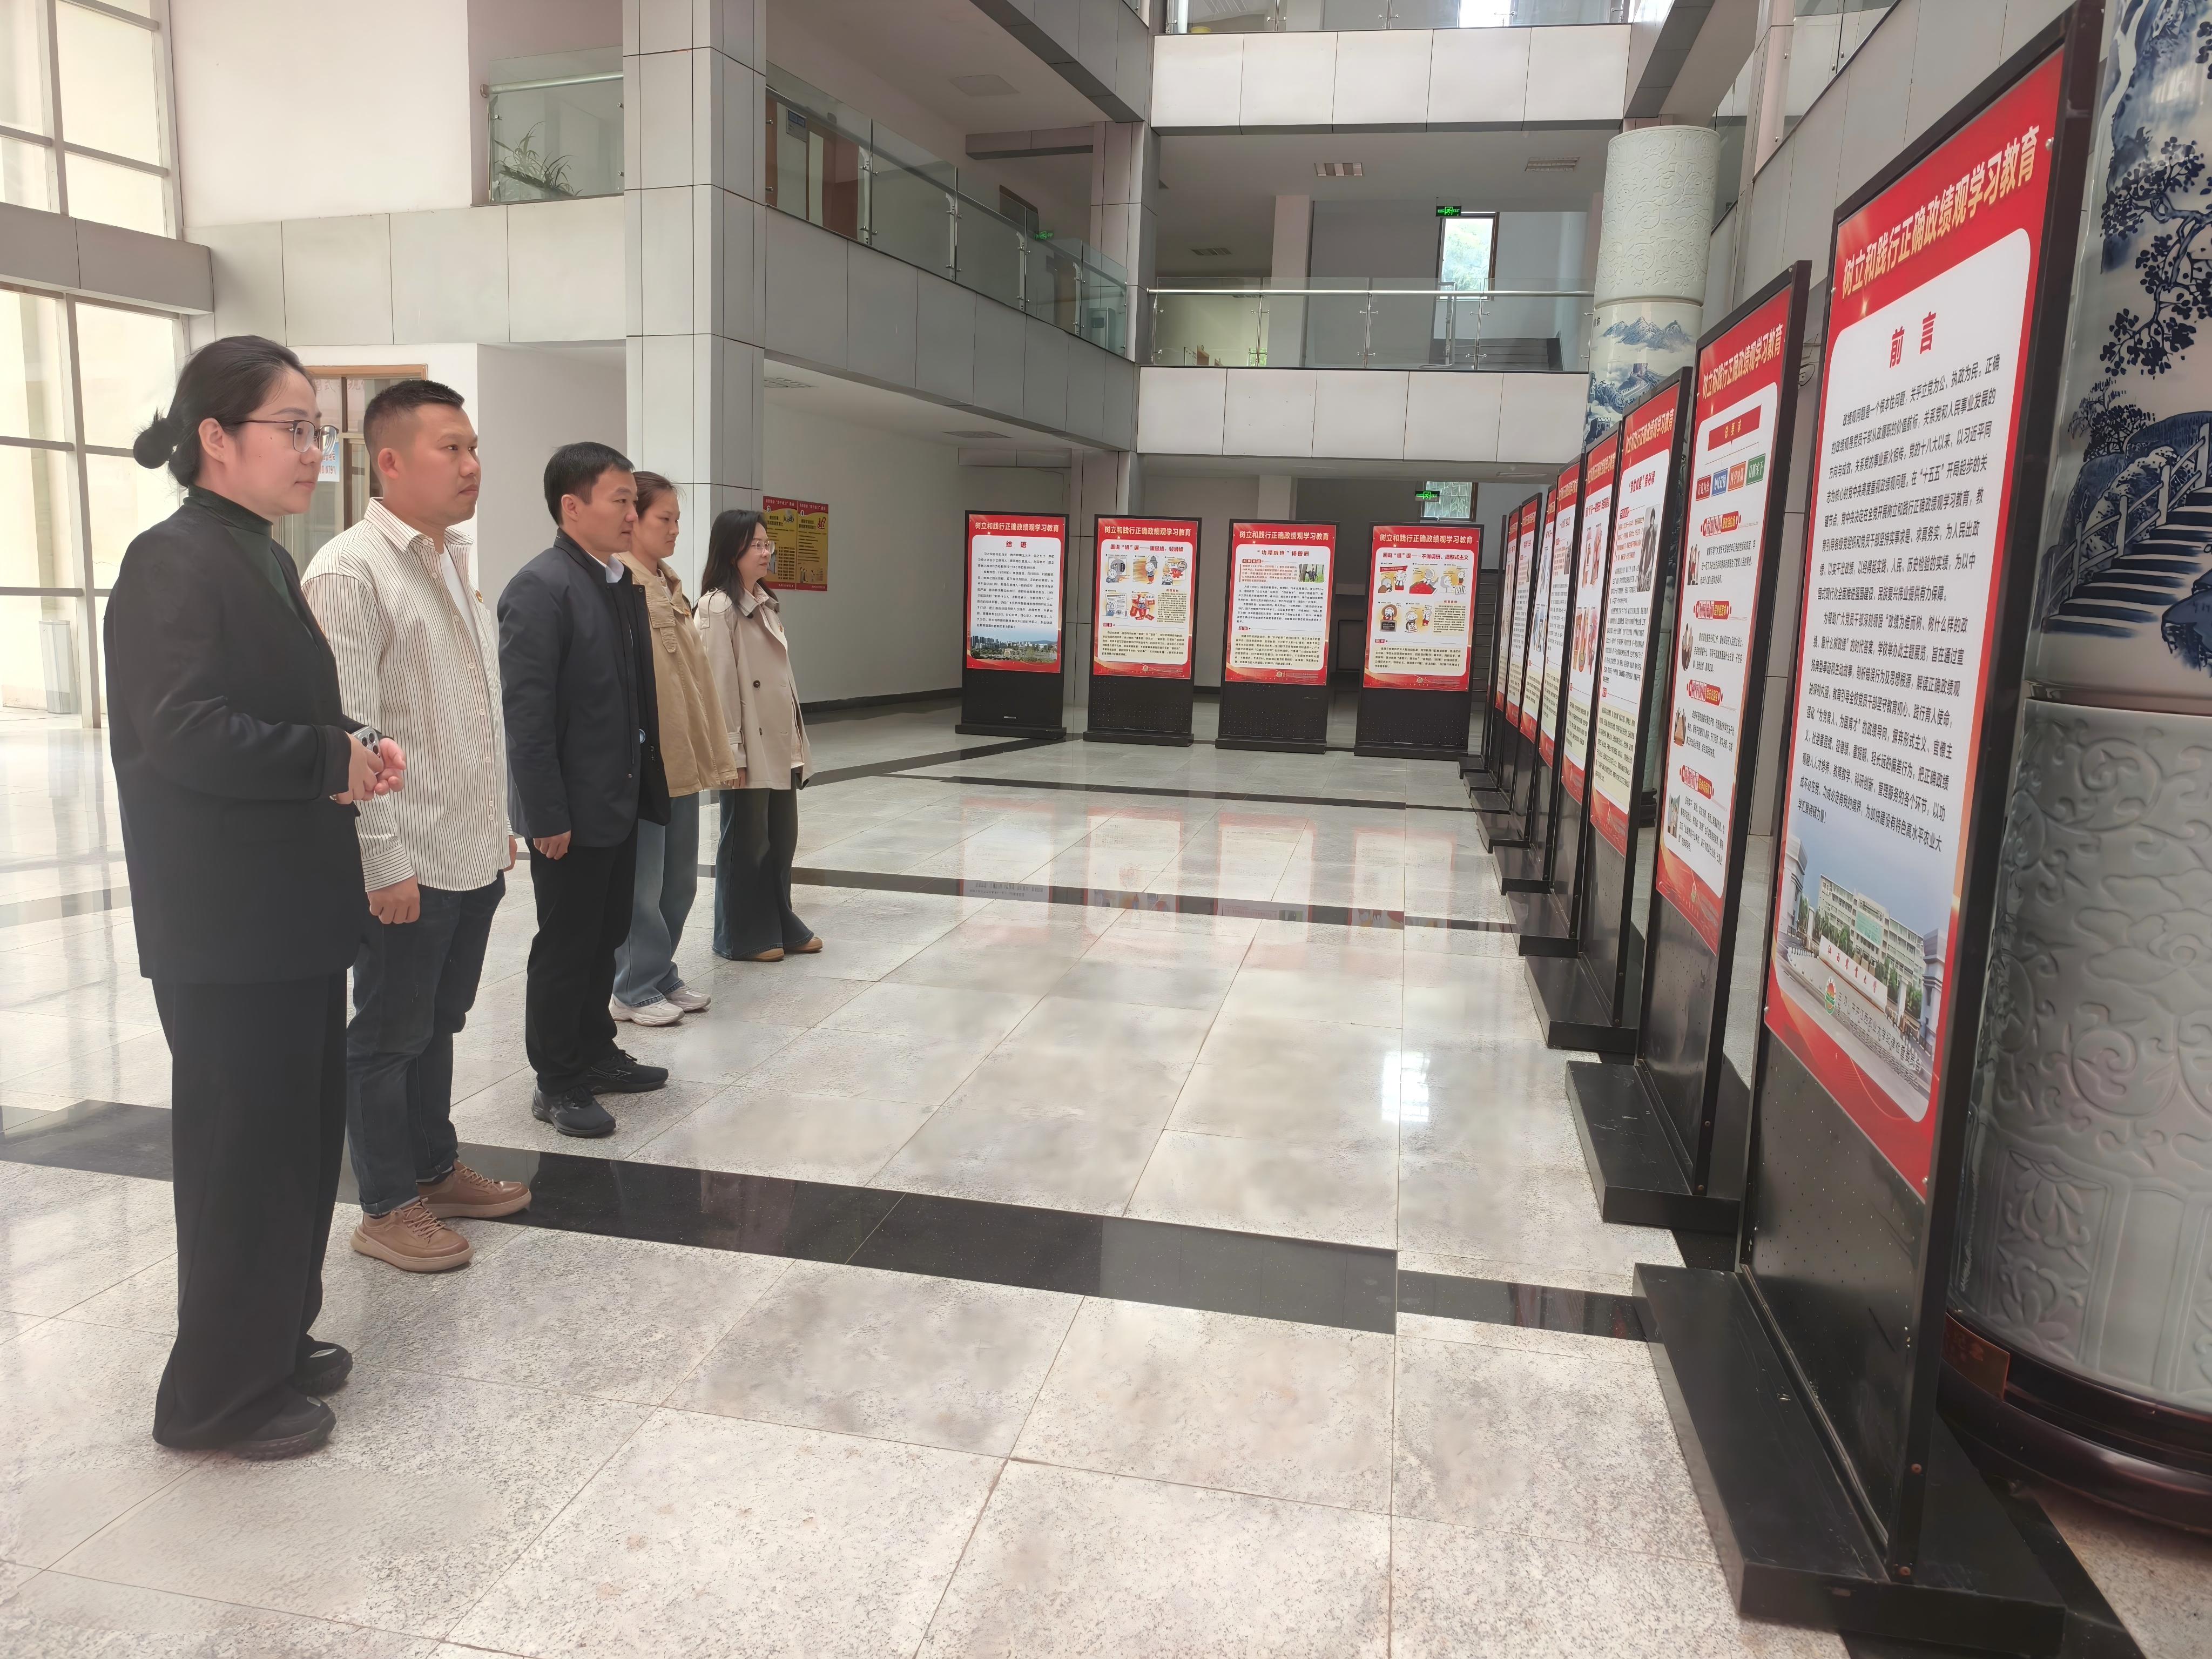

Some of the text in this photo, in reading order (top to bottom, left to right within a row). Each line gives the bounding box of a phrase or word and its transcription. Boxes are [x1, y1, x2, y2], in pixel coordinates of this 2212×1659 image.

[1842, 125, 2039, 299] 树立和践行正确政绩观学习教育
[975, 522, 1059, 532] 树立和践行正确政绩观学习教育
[1105, 525, 1191, 536] 树立和践行正确政绩观学习教育
[1239, 530, 1329, 540] 树立和践行正确政绩观学习教育
[1380, 534, 1473, 544] 树立和践行正确政绩观学习教育
